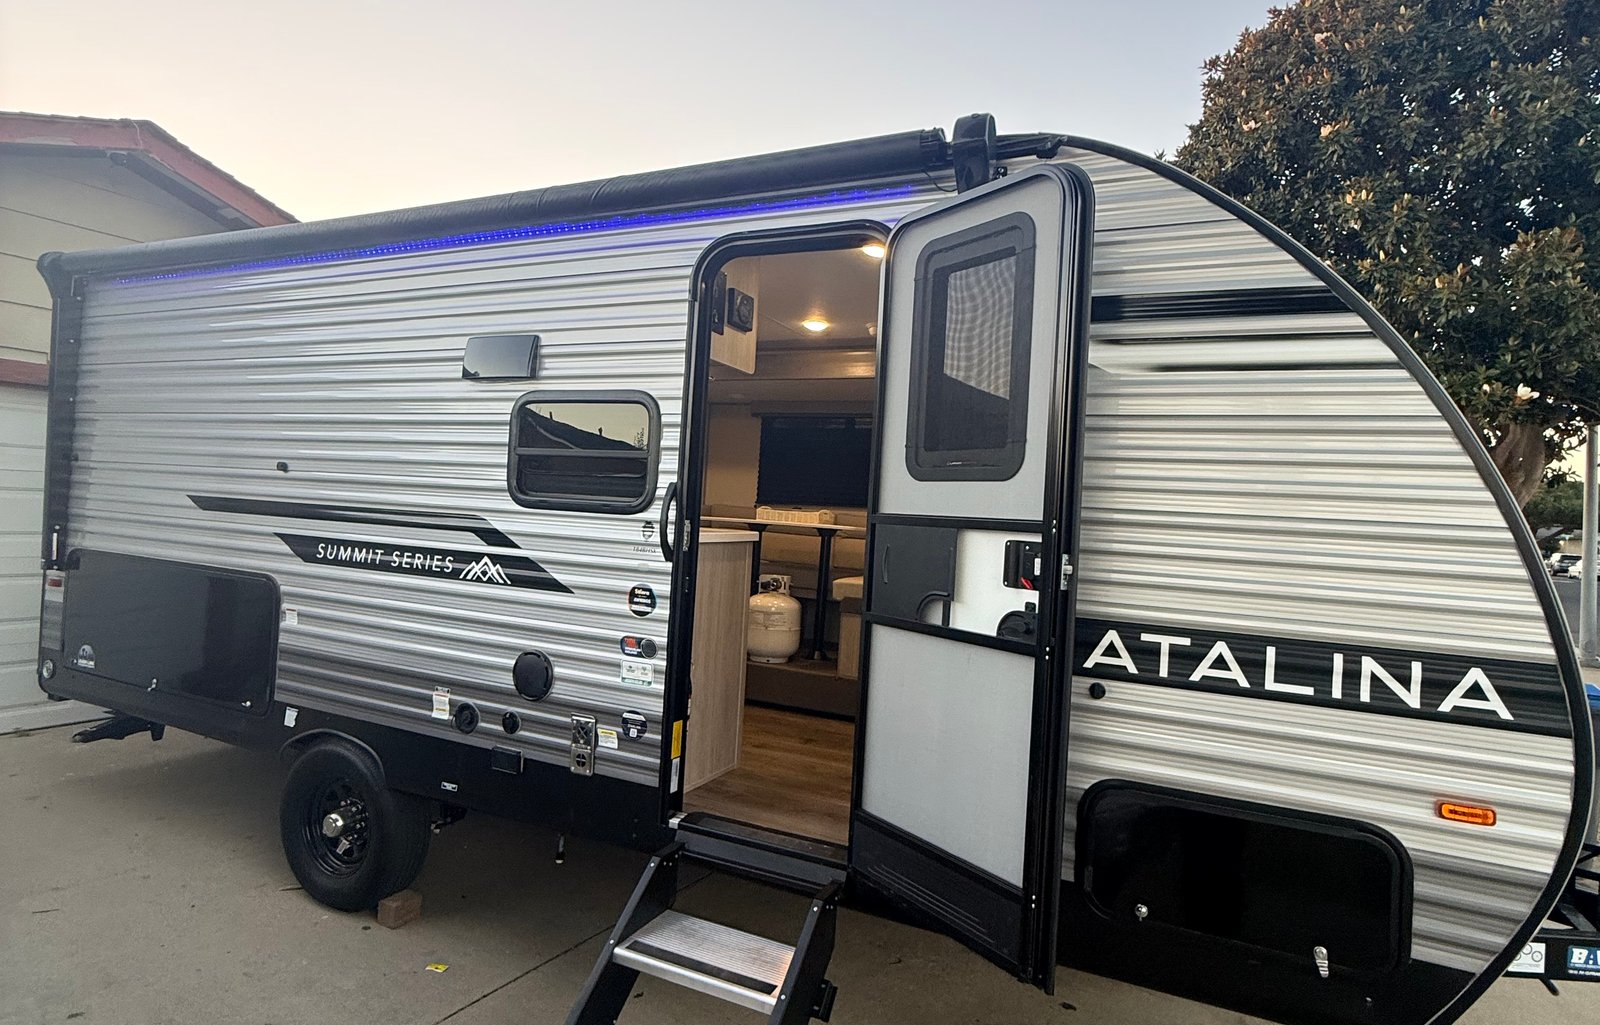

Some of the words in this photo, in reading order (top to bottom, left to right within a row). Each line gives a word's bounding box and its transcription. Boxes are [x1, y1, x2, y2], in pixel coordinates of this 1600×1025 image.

[316, 543, 384, 564] SUMMIT
[391, 551, 454, 573] SERIES
[1082, 629, 1514, 721] ATALINA
